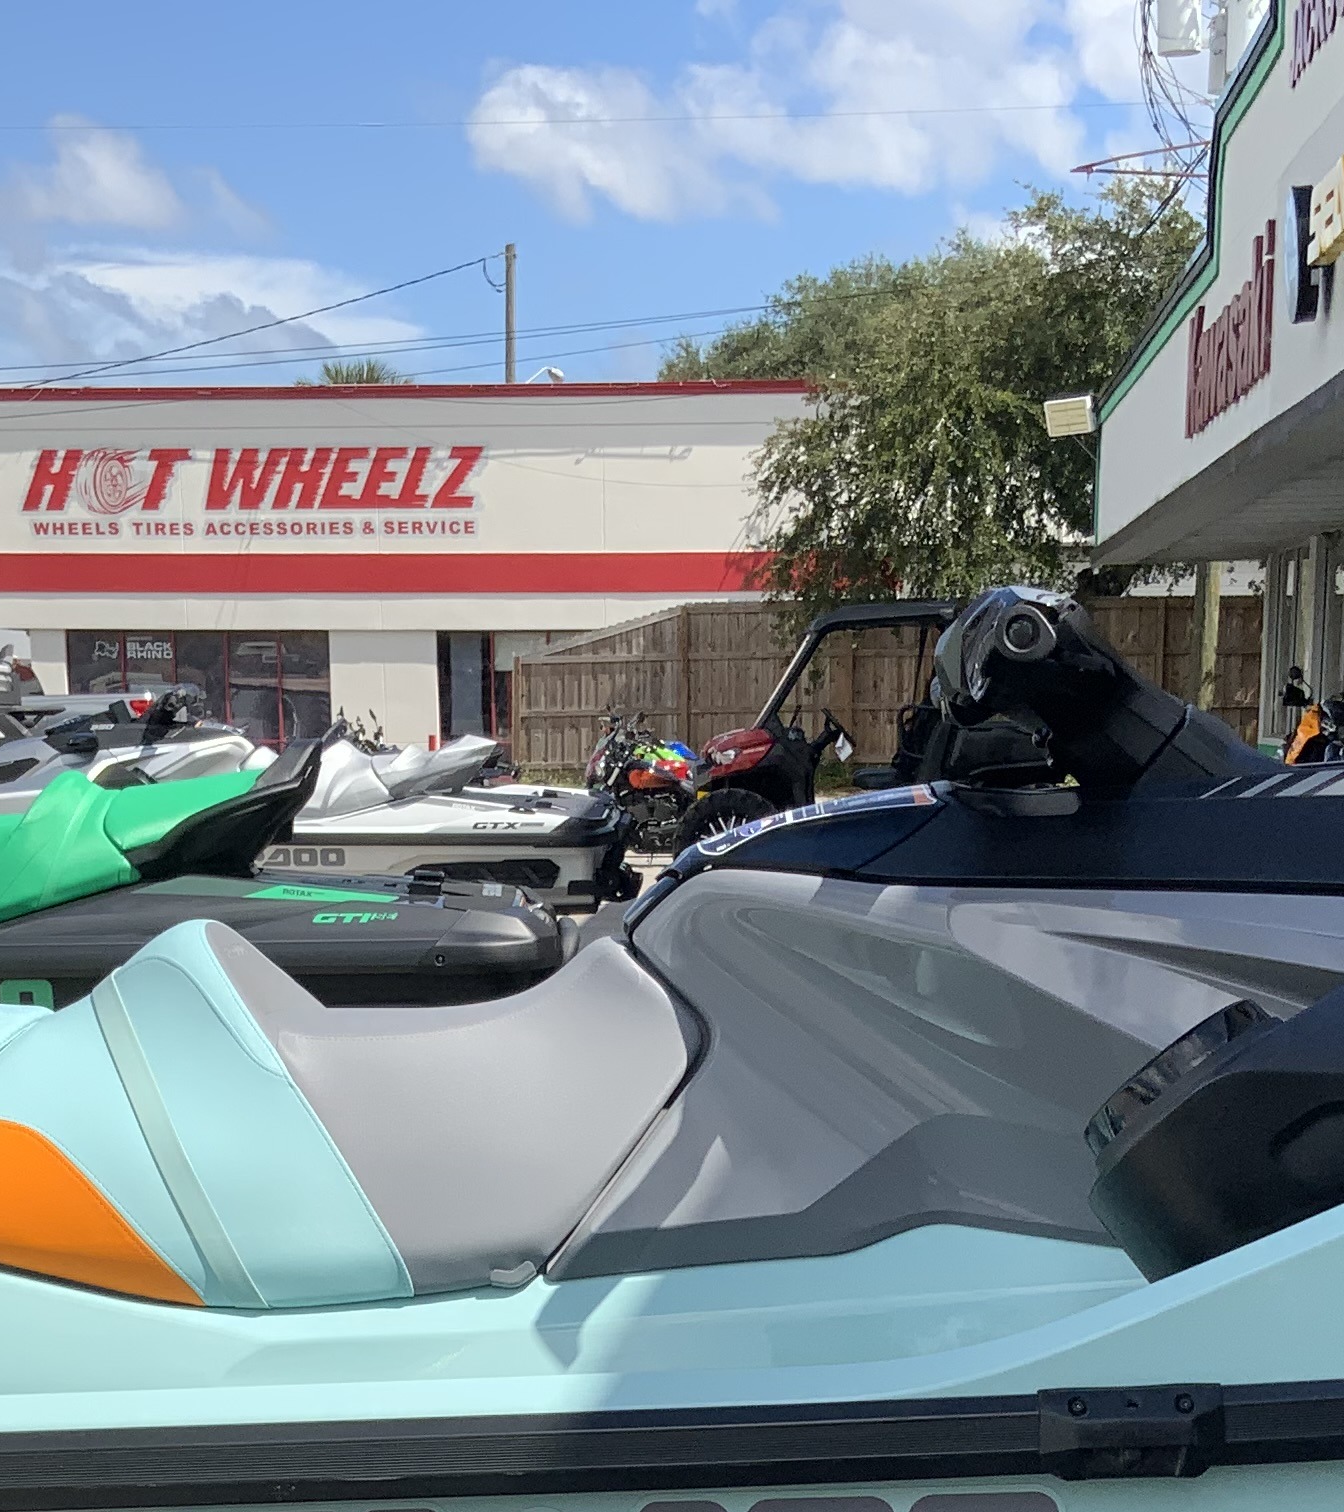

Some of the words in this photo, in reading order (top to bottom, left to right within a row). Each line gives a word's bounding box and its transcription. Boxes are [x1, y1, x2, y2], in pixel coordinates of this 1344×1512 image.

[1185, 218, 1277, 440] Kawasaki
[205, 446, 485, 511] WHEELZ
[33, 522, 120, 537] WHEELS
[132, 522, 194, 537] TIRES
[205, 521, 354, 536] ACCESSORIES
[362, 521, 375, 535] &
[383, 520, 476, 536] SERVICE
[126, 641, 172, 651] BLACK
[126, 649, 173, 659] RHINO
[471, 820, 519, 831] GTX
